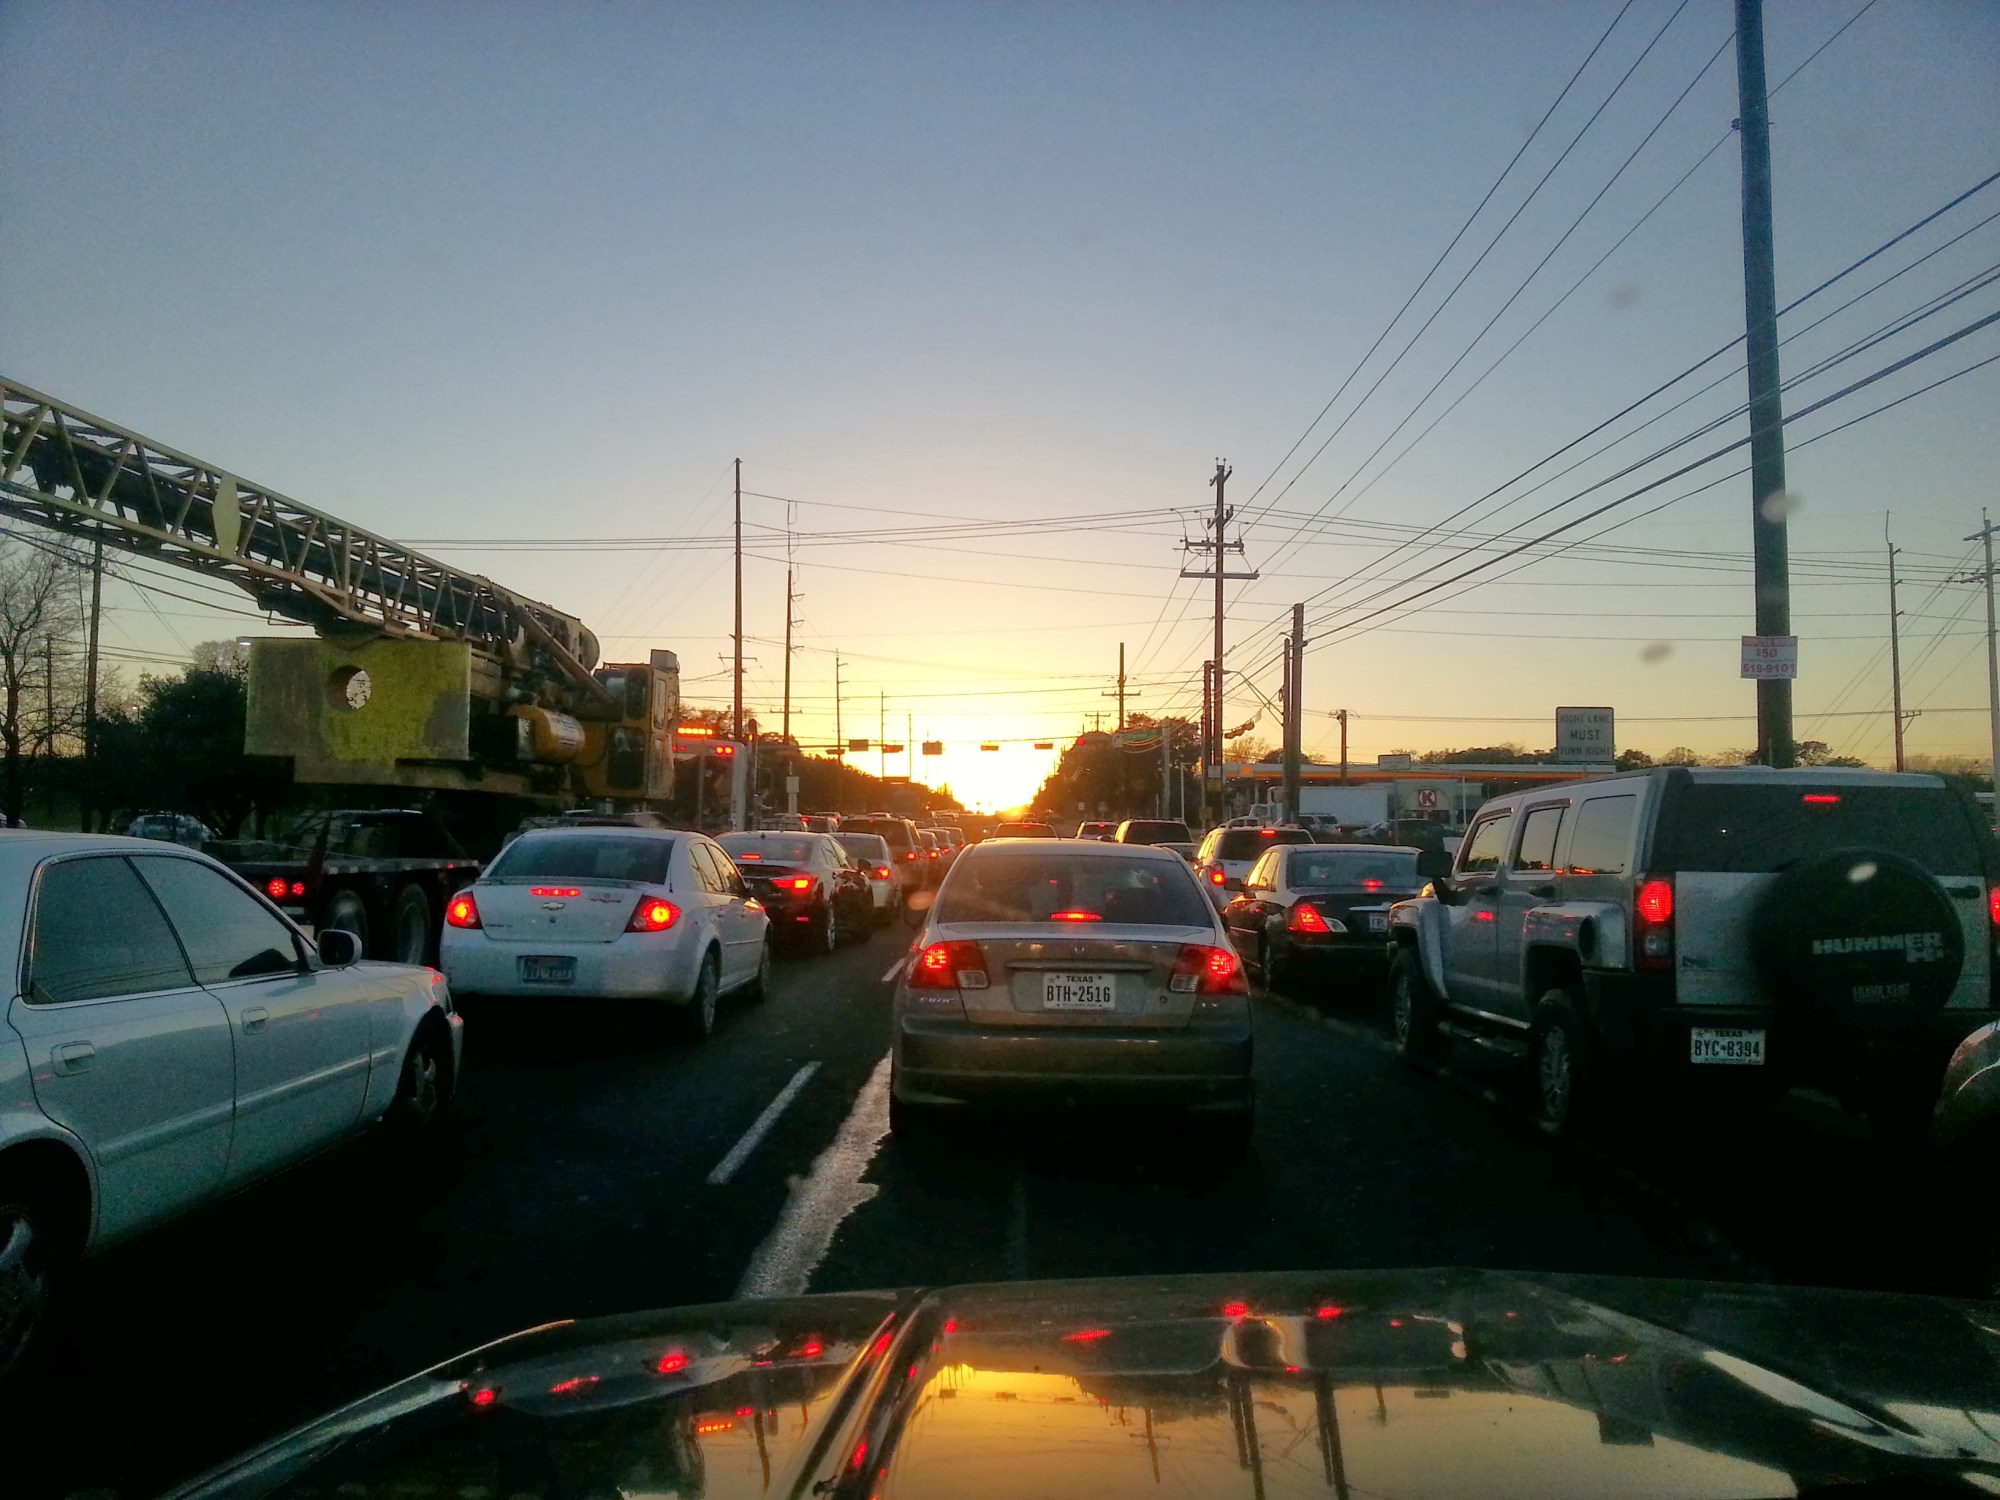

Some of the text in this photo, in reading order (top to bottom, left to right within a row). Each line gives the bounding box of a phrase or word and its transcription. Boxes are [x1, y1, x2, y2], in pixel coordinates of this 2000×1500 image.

[1755, 648, 1777, 658] $50
[1560, 714, 1610, 723] RIGHT LANE
[1570, 729, 1600, 740] MUST
[1560, 746, 1611, 756] TURN RIGHT
[1421, 791, 1435, 805] K
[1812, 932, 1943, 955] HUMMER
[1066, 975, 1094, 983] TEXAS
[1714, 1030, 1744, 1038] TEXAS
